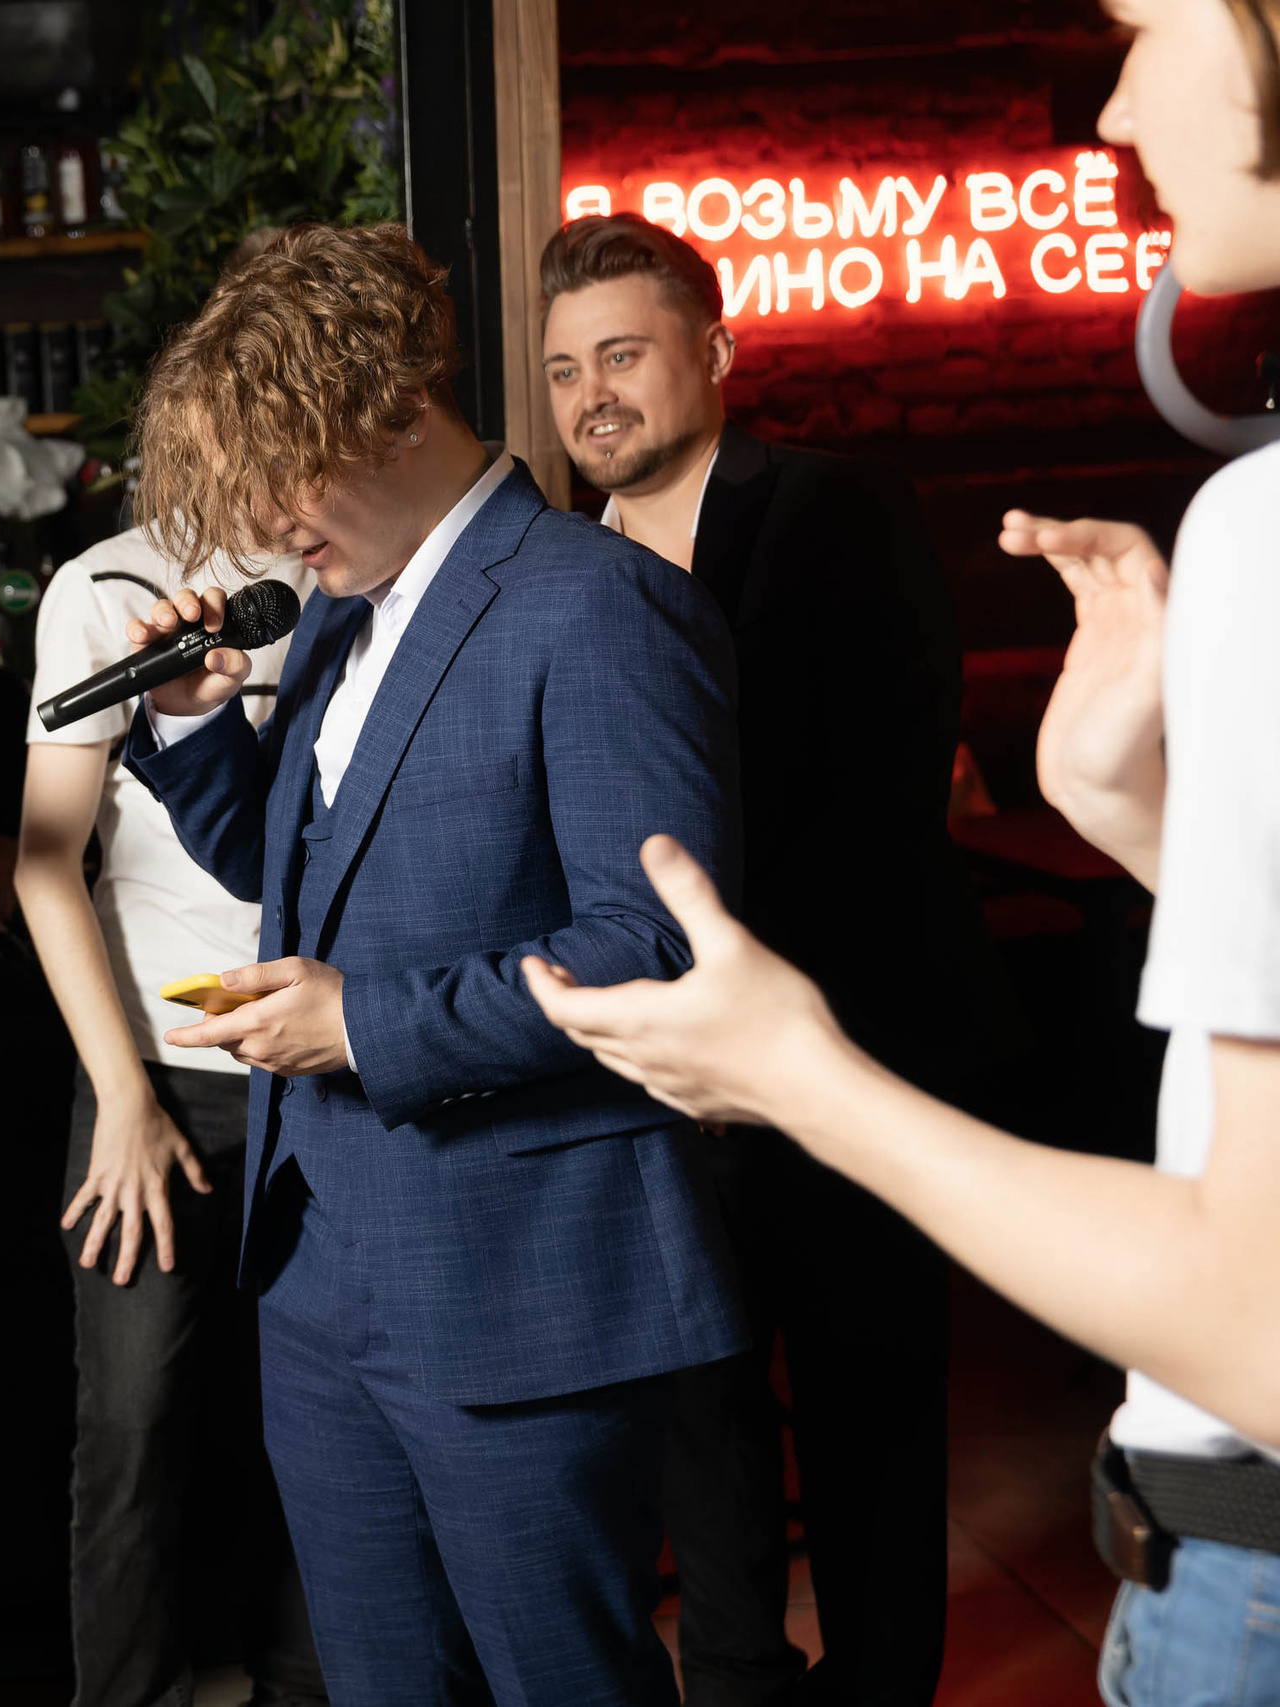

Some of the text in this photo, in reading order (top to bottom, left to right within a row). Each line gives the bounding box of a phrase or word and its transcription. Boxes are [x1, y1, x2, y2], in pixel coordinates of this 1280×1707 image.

[642, 175, 946, 242] ВОЗЬМУ
[965, 151, 1119, 231] ВСЁ
[717, 247, 883, 317] ИНО
[906, 235, 1006, 303] НА
